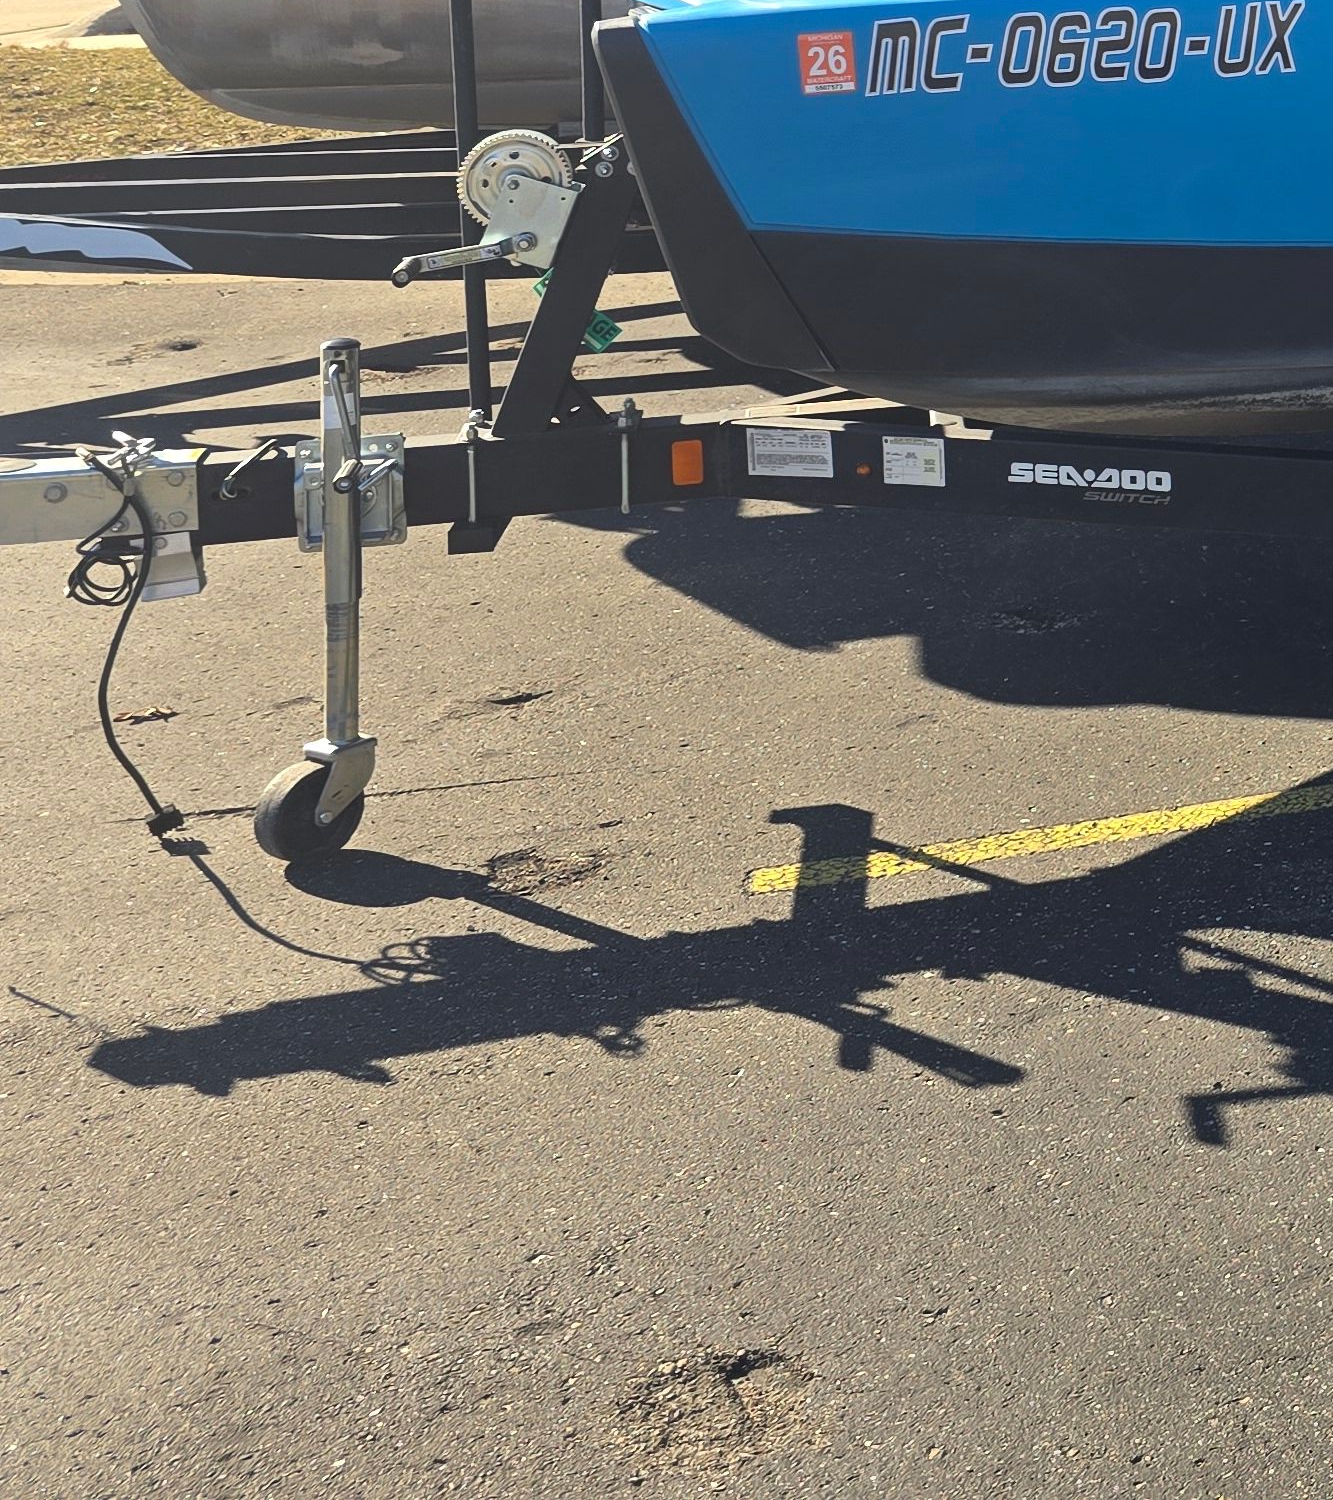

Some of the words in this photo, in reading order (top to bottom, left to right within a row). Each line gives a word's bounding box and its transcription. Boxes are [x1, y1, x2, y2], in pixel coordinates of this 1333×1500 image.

[807, 44, 847, 77] 26
[865, 0, 1306, 97] MC-0620-UX
[1083, 491, 1171, 505] SWITCH
